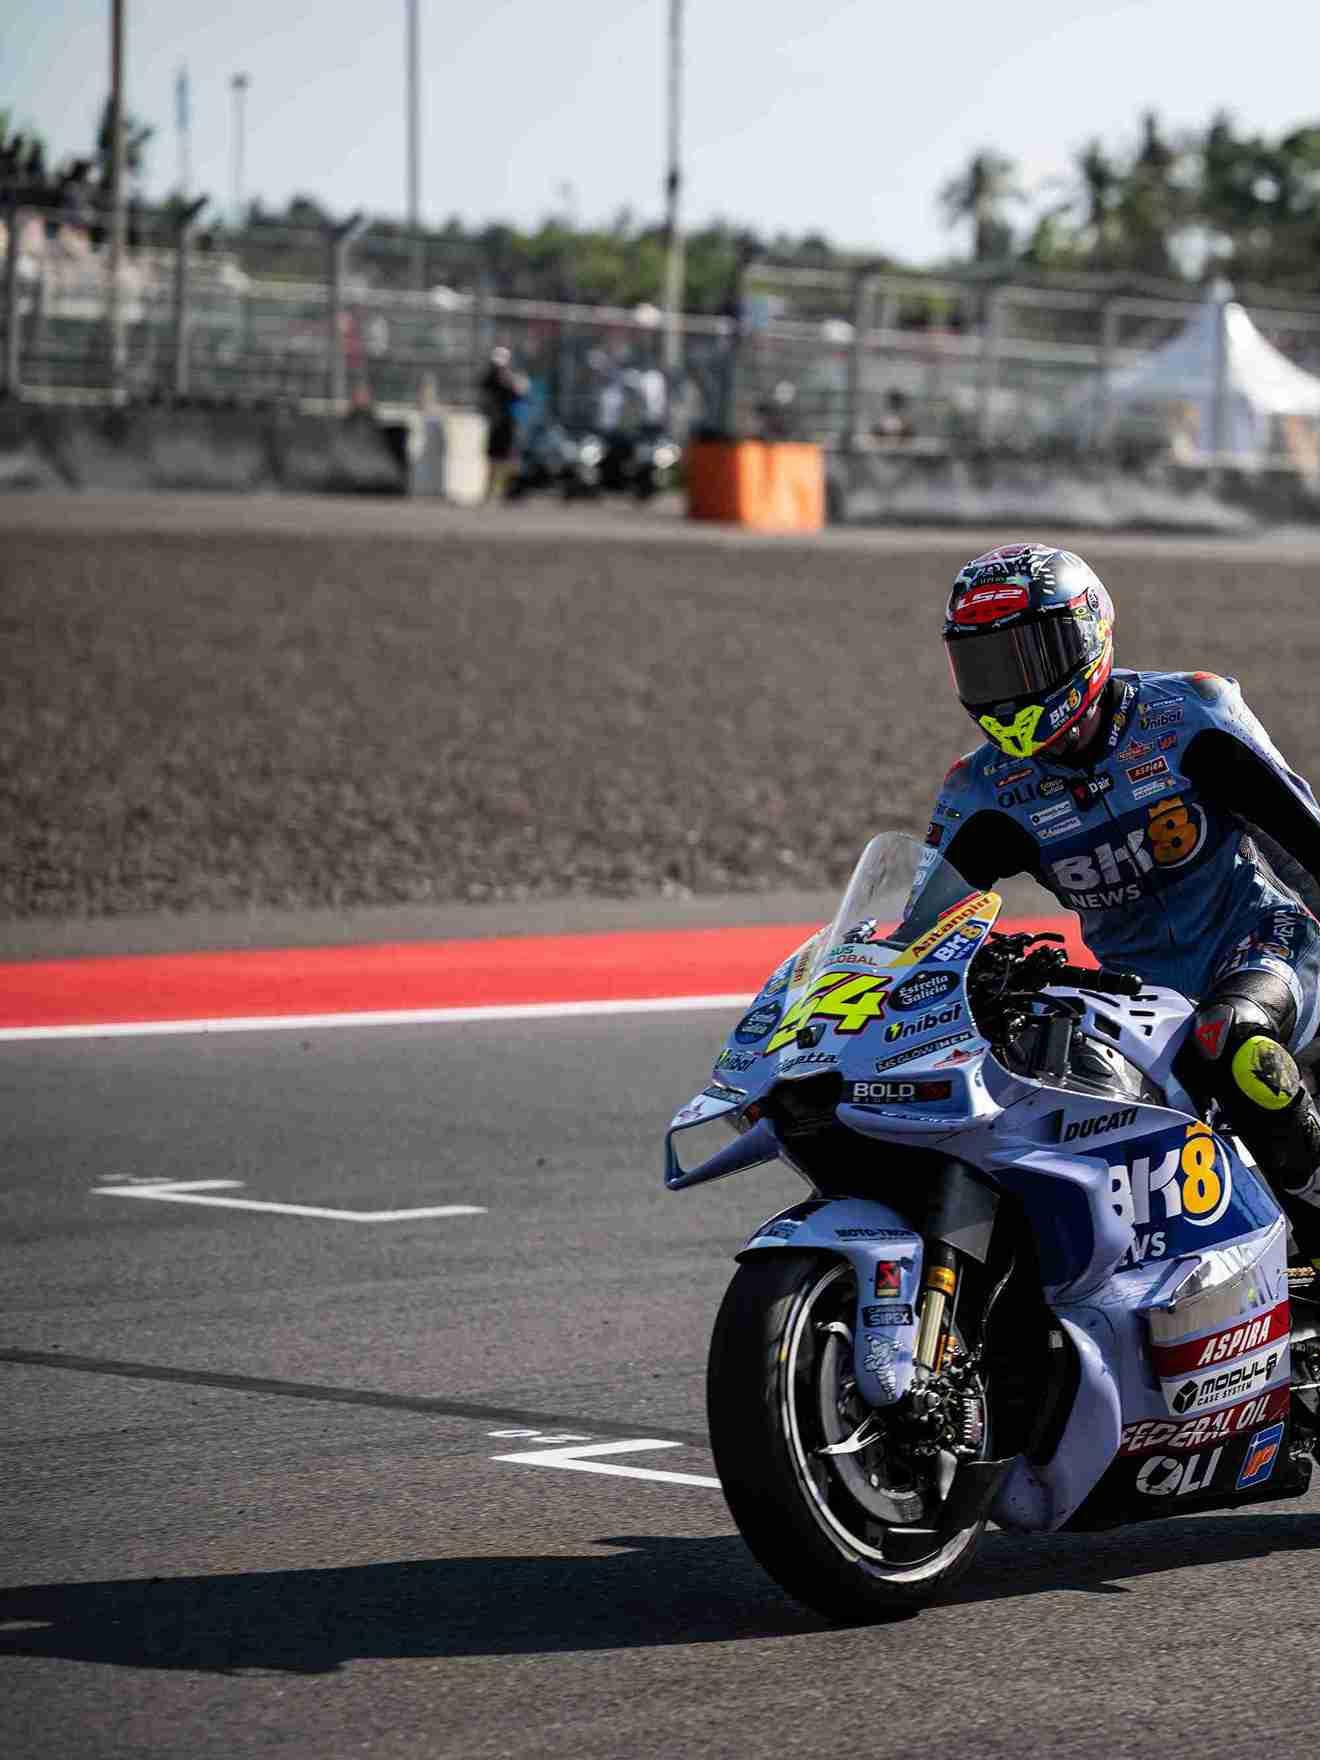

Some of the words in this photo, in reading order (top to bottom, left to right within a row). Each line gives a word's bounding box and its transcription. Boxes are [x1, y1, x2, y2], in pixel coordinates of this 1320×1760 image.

[1052, 800, 1205, 890] BK8
[1069, 884, 1141, 908] NEWS
[933, 923, 986, 962] BK8
[898, 974, 949, 997] Estrella
[902, 983, 948, 1006] Galicia
[884, 1002, 962, 1043] Unibat
[852, 1083, 915, 1098] BOLD
[1063, 1107, 1139, 1142] DUCATI
[869, 1312, 910, 1325] SIPEX
[1197, 1315, 1272, 1366] ASPIRA
[1197, 1391, 1219, 1406] CASE
[1222, 1379, 1253, 1399] SYSTEM
[1121, 1408, 1236, 1452] FEDERAL
[1236, 1393, 1273, 1431] OIL
